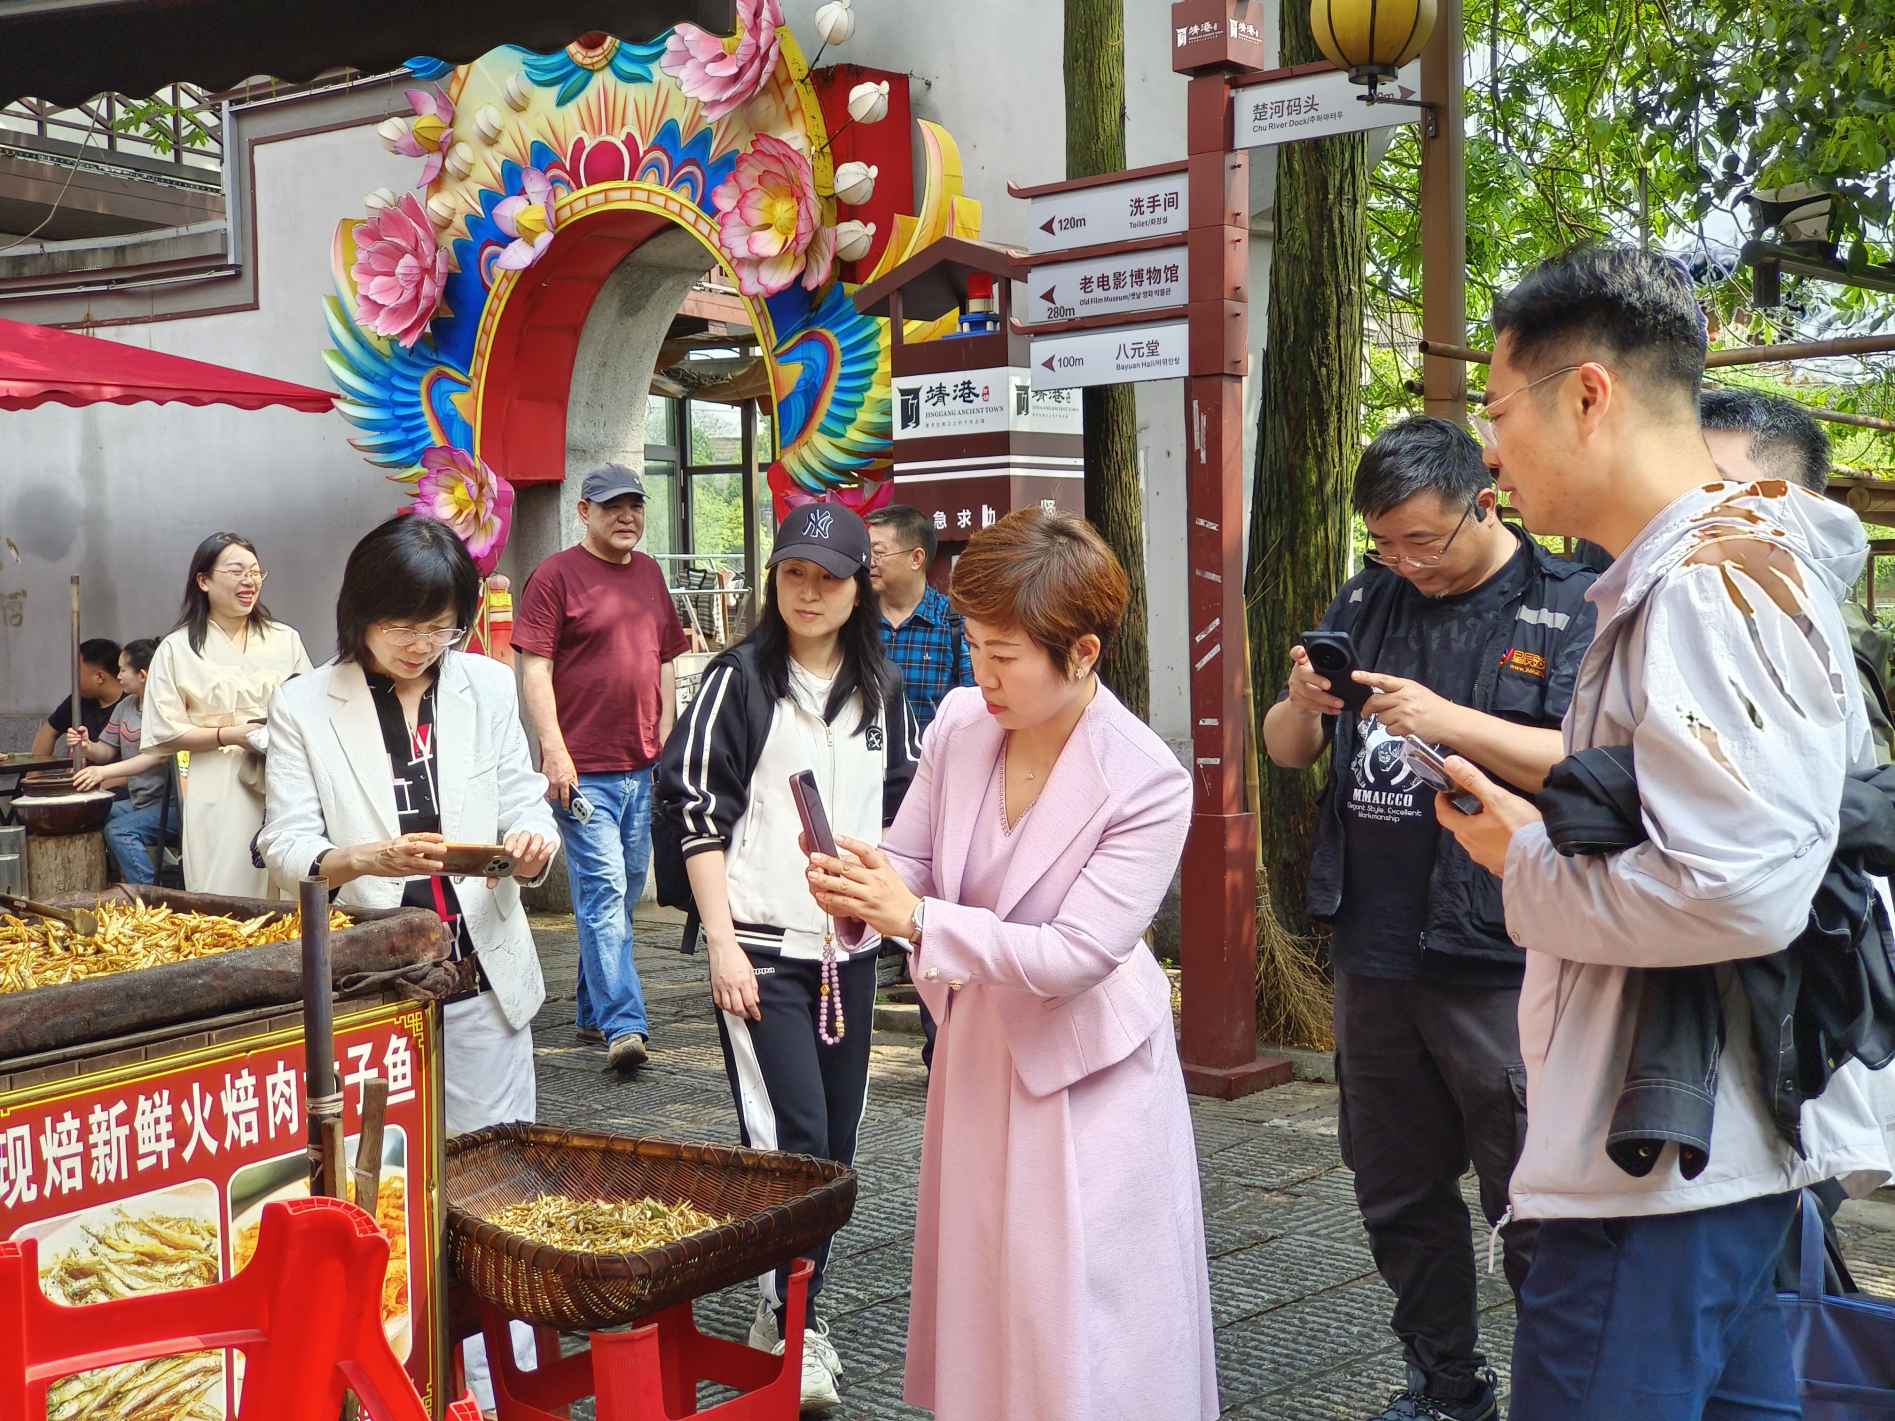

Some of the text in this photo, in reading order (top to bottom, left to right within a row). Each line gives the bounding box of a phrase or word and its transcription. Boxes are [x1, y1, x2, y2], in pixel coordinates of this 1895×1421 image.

[1252, 94, 1319, 122] 楚河码头
[1252, 124, 1267, 133] Chu
[1268, 121, 1288, 131] River
[1129, 191, 1179, 217] 洗手间
[1058, 217, 1086, 231] 120m
[1079, 263, 1180, 294] 老电影博物馆
[1090, 296, 1103, 305] Film
[1047, 306, 1075, 319] 280m
[1115, 340, 1160, 360] 八元堂
[1058, 355, 1084, 368] 100m
[924, 380, 979, 407] 靖港
[957, 406, 984, 416] ANCIENT
[984, 405, 1004, 415] TOWN
[1352, 788, 1413, 807] MMAICCO
[0, 1033, 416, 1209] 现焙新鲜火焙肉子鱼
